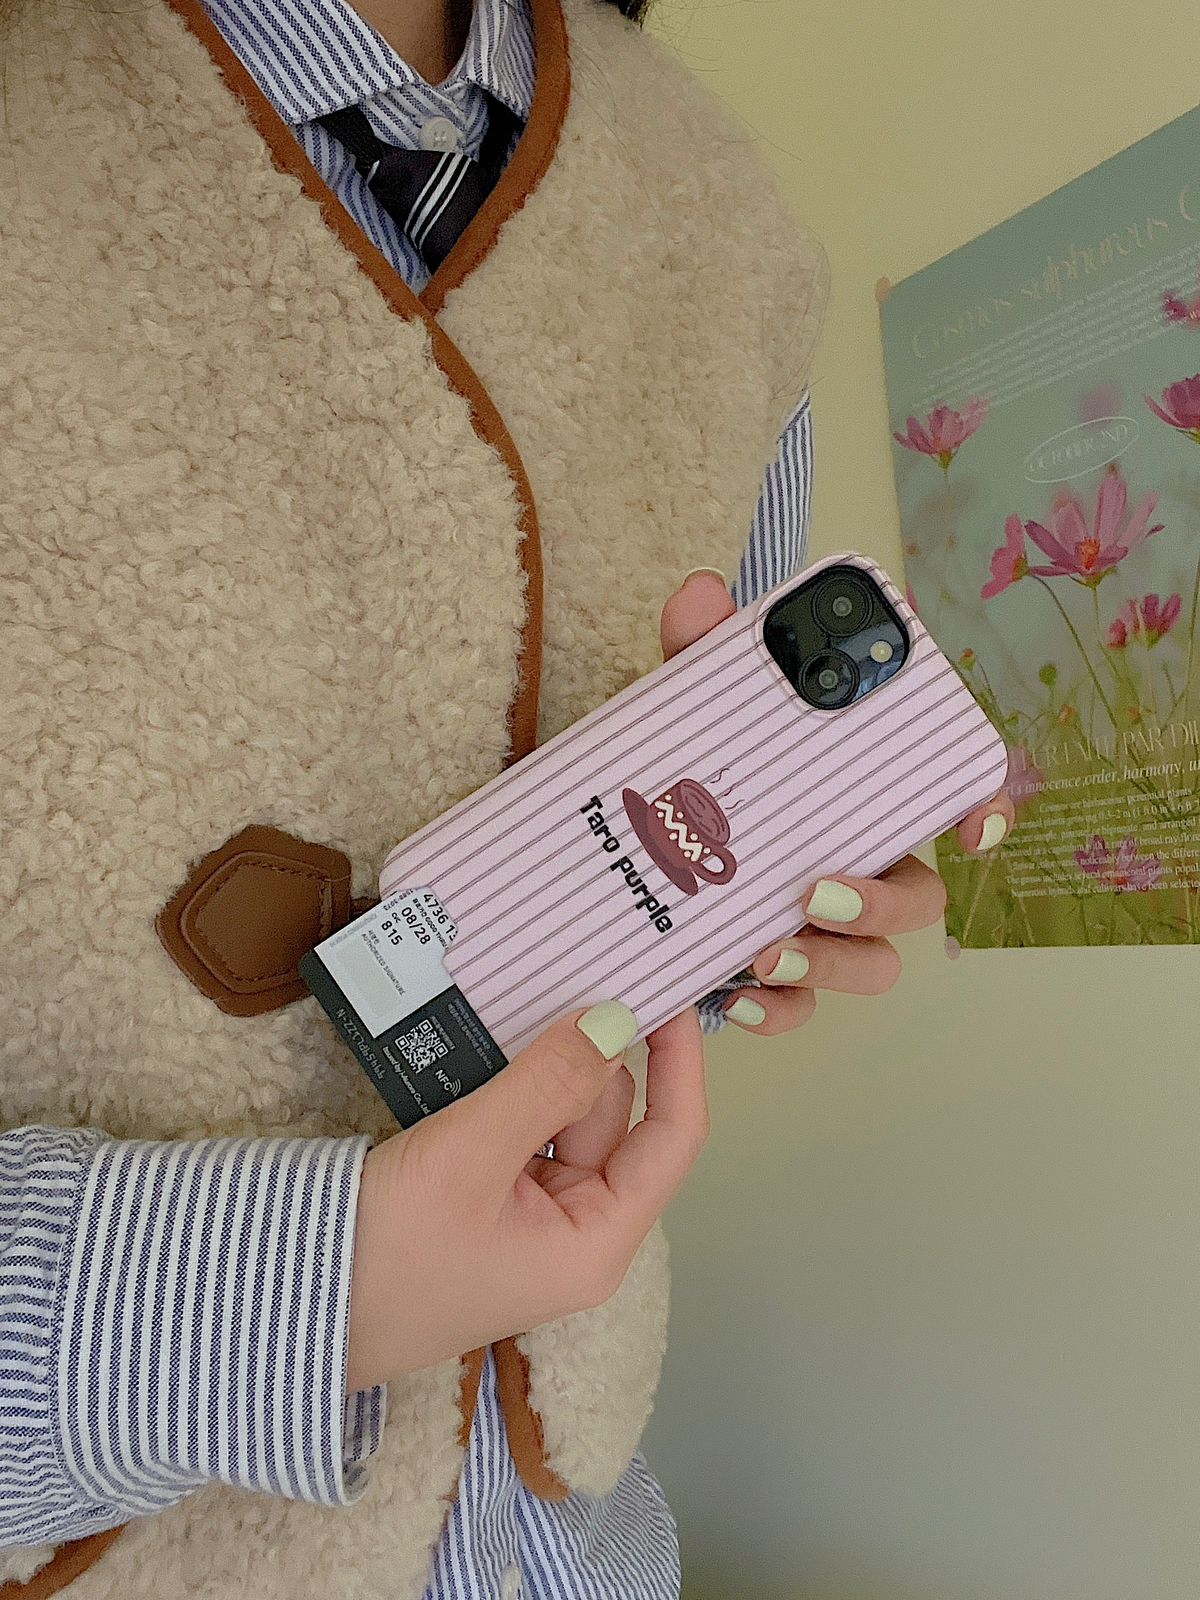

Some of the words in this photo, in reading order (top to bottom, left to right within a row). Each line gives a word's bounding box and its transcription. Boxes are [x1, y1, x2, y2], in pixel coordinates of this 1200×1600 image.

[579, 795, 621, 853] Taro
[610, 855, 673, 933] purple
[423, 893, 449, 925] 4736
[381, 920, 403, 946] 815
[401, 906, 431, 945] 08/28
[435, 1069, 453, 1091] NFC
